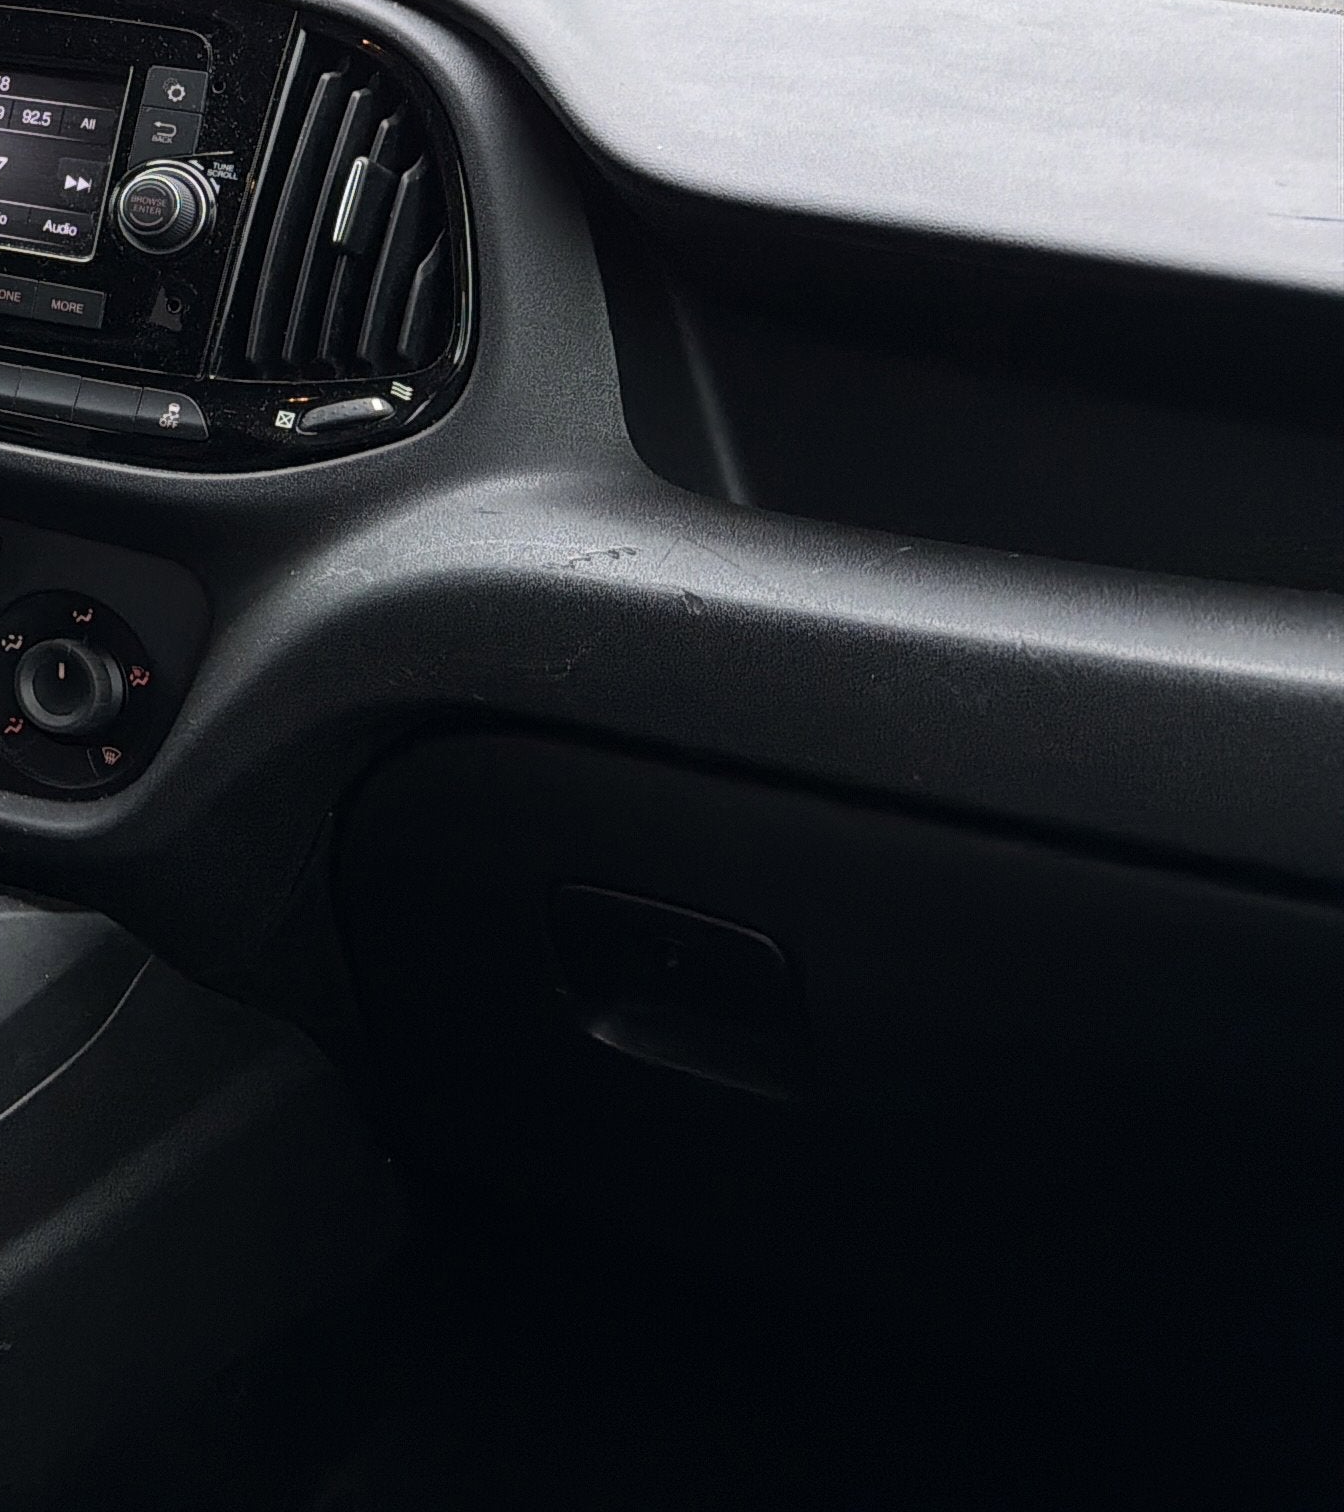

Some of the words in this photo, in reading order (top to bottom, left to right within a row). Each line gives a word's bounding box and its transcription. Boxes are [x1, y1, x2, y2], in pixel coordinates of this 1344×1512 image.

[22, 109, 52, 127] 92.5
[79, 117, 97, 131] All
[152, 134, 172, 144] BACK
[213, 161, 235, 172] TUNE
[206, 169, 239, 181] SCROLL
[130, 193, 168, 208] BROWSE
[133, 204, 162, 216] ENTER
[42, 219, 78, 237] Audio
[50, 298, 85, 315] MORE
[159, 416, 179, 429] OFF
